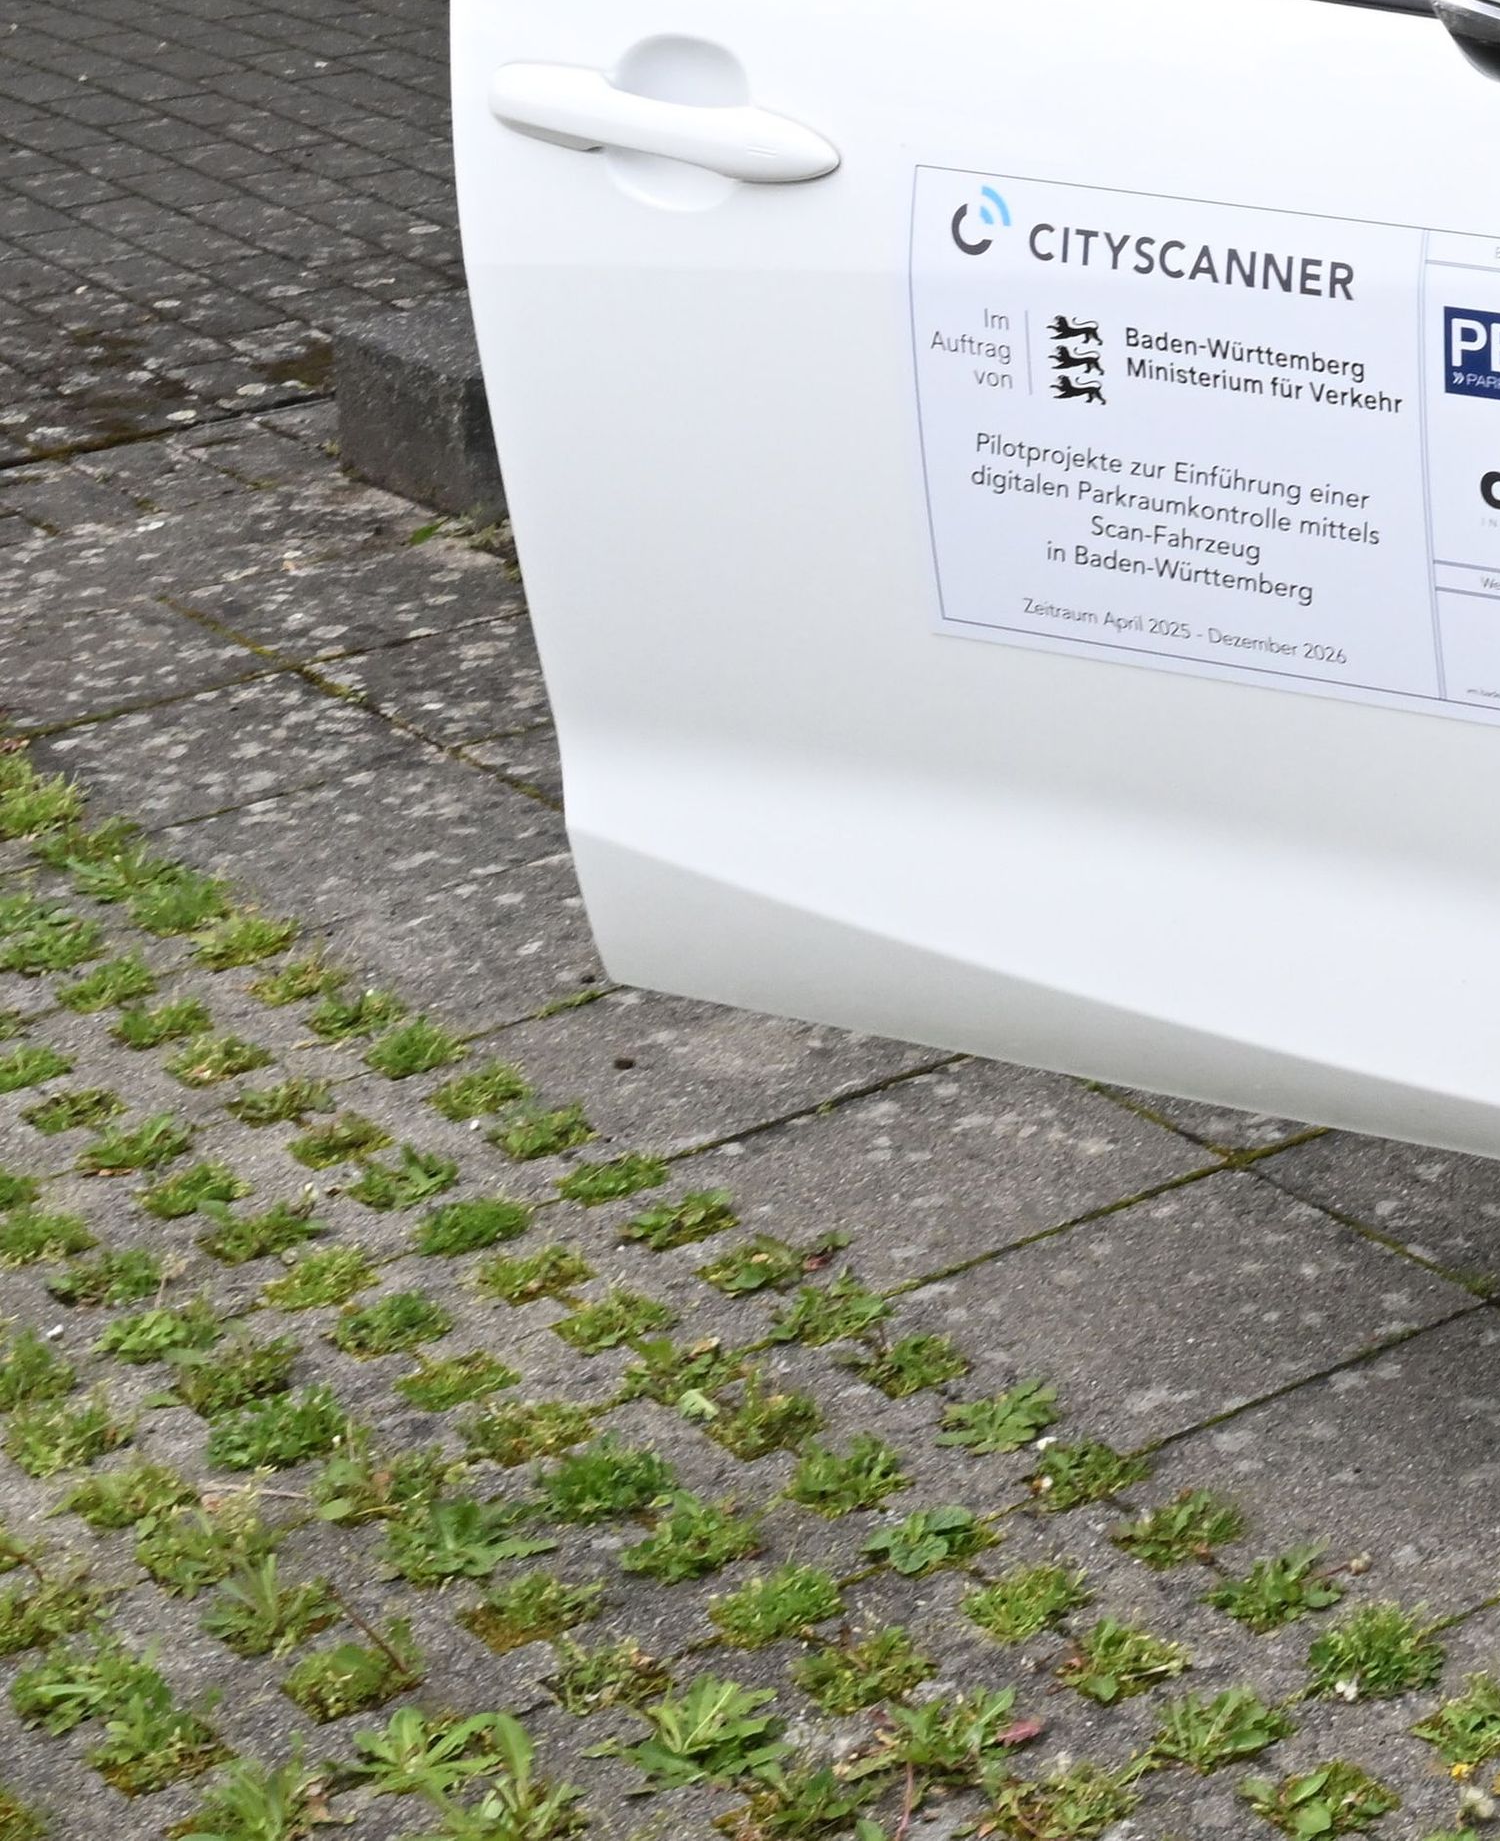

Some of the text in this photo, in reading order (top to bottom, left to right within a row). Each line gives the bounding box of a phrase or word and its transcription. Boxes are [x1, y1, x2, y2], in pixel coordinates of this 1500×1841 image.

[1029, 224, 1355, 301] CITYSCANNER
[984, 307, 1009, 331] Im
[930, 331, 1011, 366] Auftrag
[1125, 327, 1365, 384] Baden-Württemberg
[974, 369, 1013, 390] von
[1127, 357, 1403, 414] Ministerium für Verkehr
[976, 433, 1371, 510] Pilotprojekte zur Einführung einer
[971, 466, 1381, 546] digitalen Parkraumkontrolle mittels
[1091, 516, 1261, 565] Scan-Fahrzeug
[1047, 541, 1314, 607] in Baden-Württemberg
[1023, 598, 1098, 626] Zeitraum
[1103, 611, 1143, 635] April
[1148, 619, 1191, 640] 2025
[1208, 628, 1298, 657] Dezember
[1303, 643, 1348, 665] 2026
